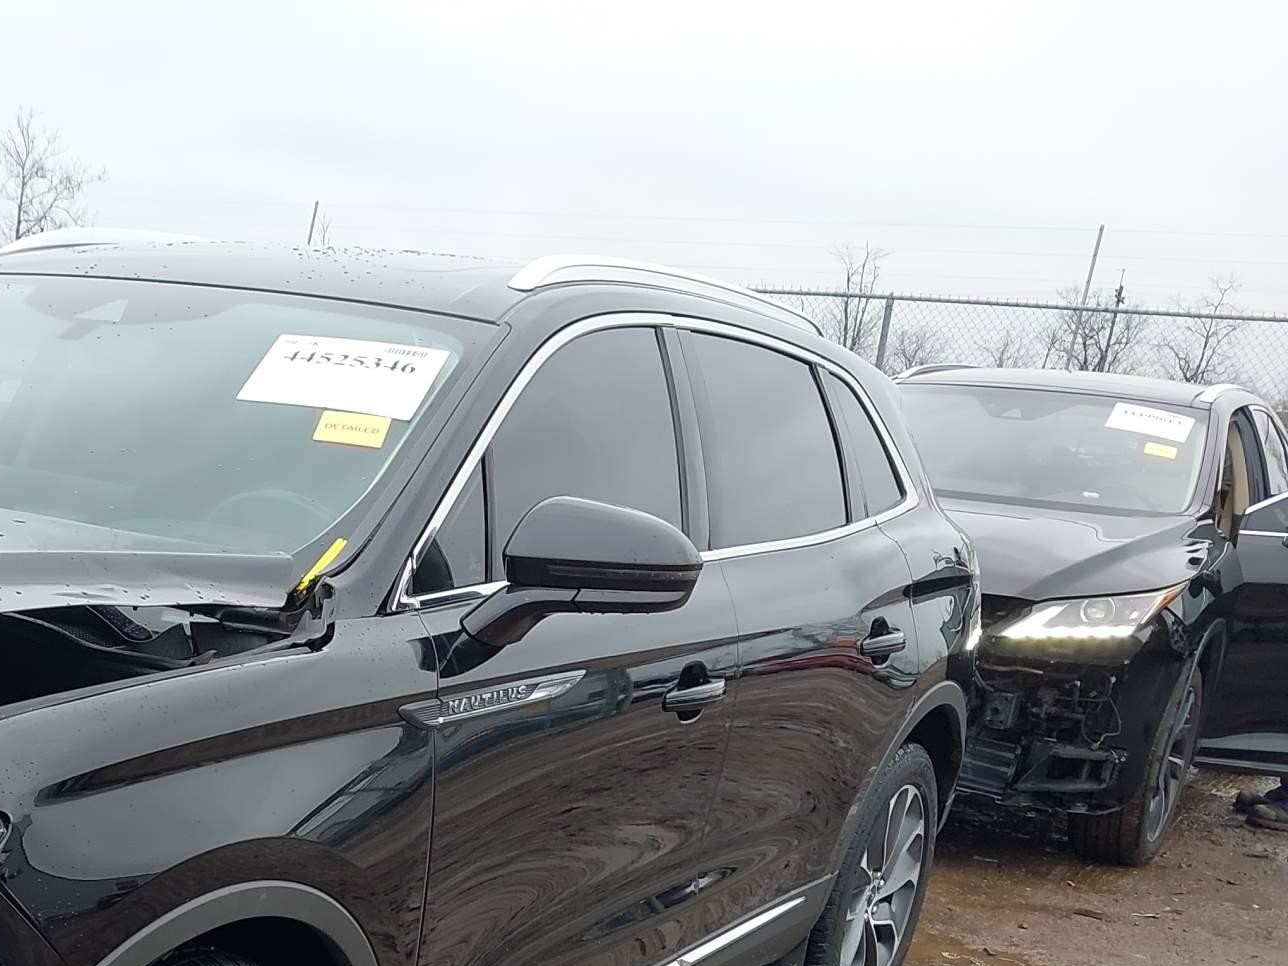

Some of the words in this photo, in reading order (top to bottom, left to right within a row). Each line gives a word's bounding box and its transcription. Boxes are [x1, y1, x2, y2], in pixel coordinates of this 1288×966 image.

[283, 350, 416, 375] 44525346
[324, 422, 380, 434] DETAILED
[448, 685, 528, 715] NAUTILUS
